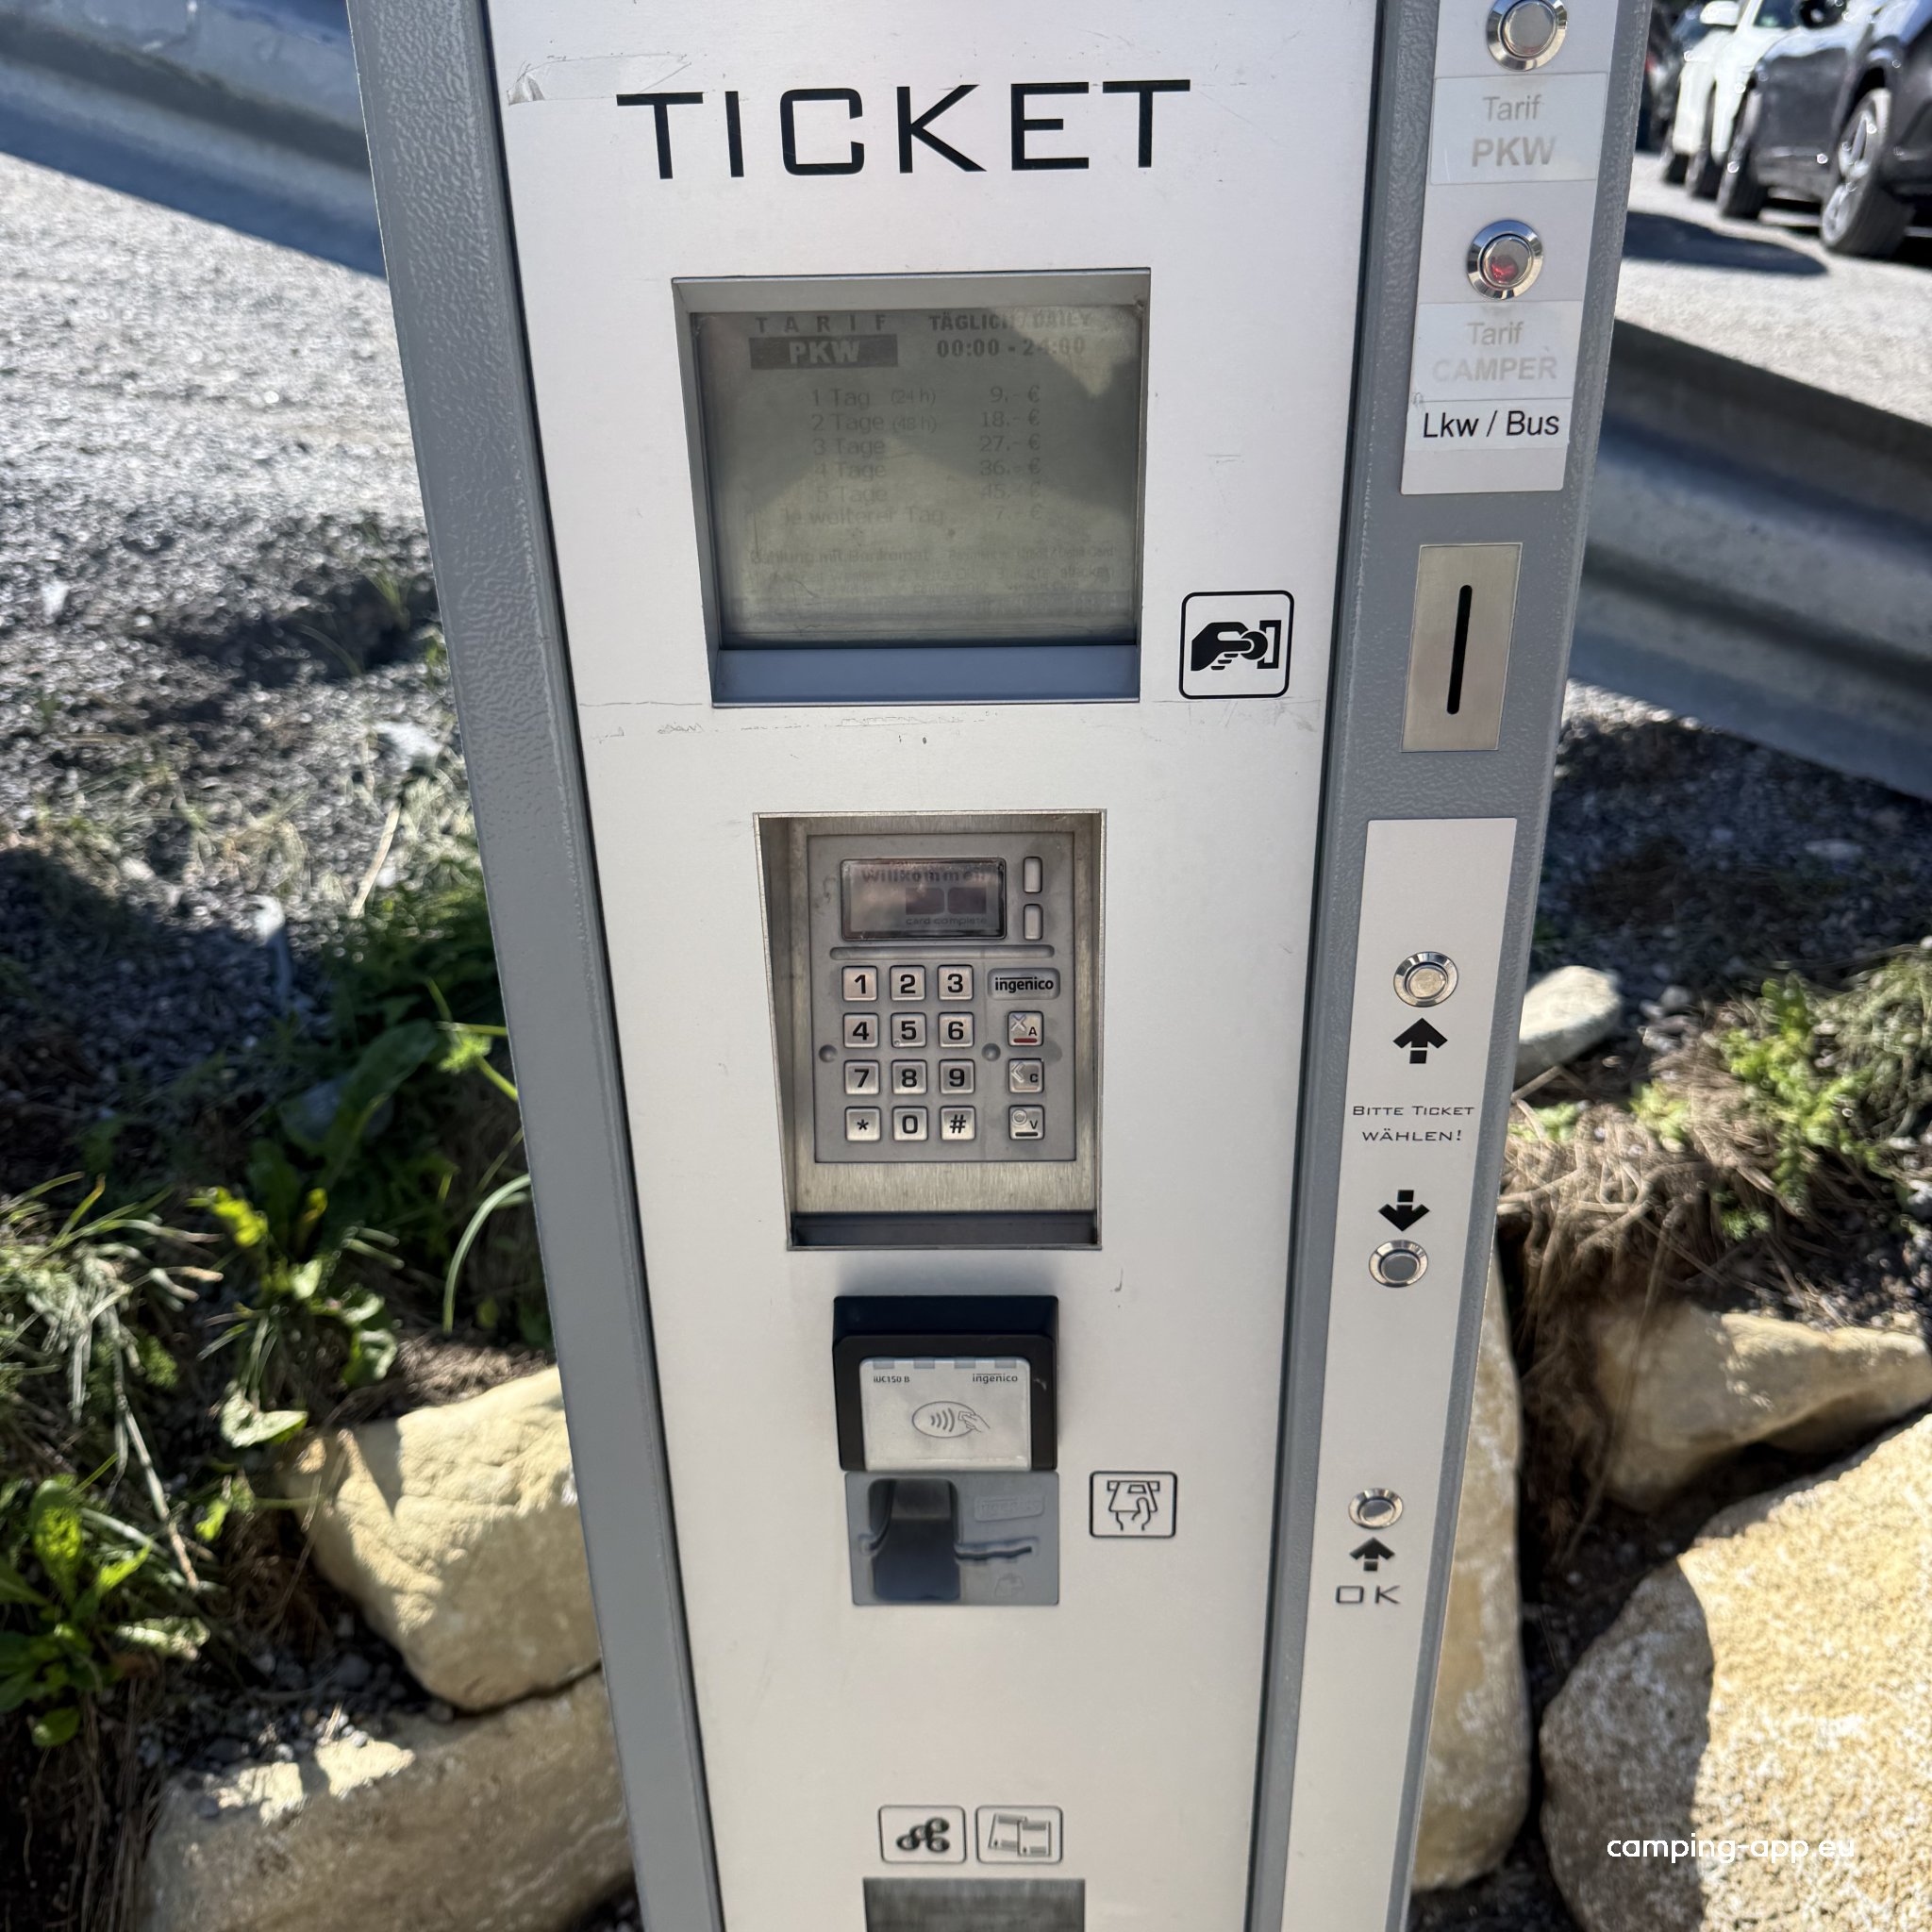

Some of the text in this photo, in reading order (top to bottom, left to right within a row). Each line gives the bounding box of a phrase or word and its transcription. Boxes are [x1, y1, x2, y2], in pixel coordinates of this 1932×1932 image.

[1482, 94, 1541, 122] Tarif
[616, 79, 1191, 179] TICKET
[1472, 137, 1554, 167] PKW
[1467, 322, 1524, 346] Tarif
[789, 341, 861, 364] PKW
[937, 339, 1000, 358] 00:00
[1023, 336, 1086, 357] 24:00
[1432, 357, 1557, 382] CAMPER
[811, 388, 821, 406] 1
[830, 388, 871, 409] Tag
[1027, 385, 1041, 403] €
[811, 413, 824, 431] 2
[830, 413, 884, 434] Tage
[1027, 408, 1041, 426] €
[1423, 410, 1559, 438] Lkw / Bus
[812, 438, 825, 456] 3
[835, 437, 886, 459] Tage
[1027, 433, 1041, 451] €
[814, 462, 827, 479] 4
[836, 462, 888, 482] Tage
[1027, 458, 1041, 475] €
[816, 487, 829, 503] 5
[836, 485, 888, 507] Tage
[808, 508, 895, 525] weiterer
[905, 507, 945, 528] Tag
[861, 869, 988, 883] Willkommen
[906, 916, 988, 926] card complete
[854, 973, 963, 994] 1 2 3
[994, 976, 1054, 993] ingenico
[852, 1020, 964, 1041] 4 5 6
[1028, 1026, 1038, 1036] A
[854, 1068, 965, 1088] 7 8 9
[902, 1114, 966, 1134] 0 #
[1362, 1127, 1461, 1141] WÄHLEN!
[972, 1373, 1018, 1384] ingenico
[1335, 1585, 1401, 1604] OK
